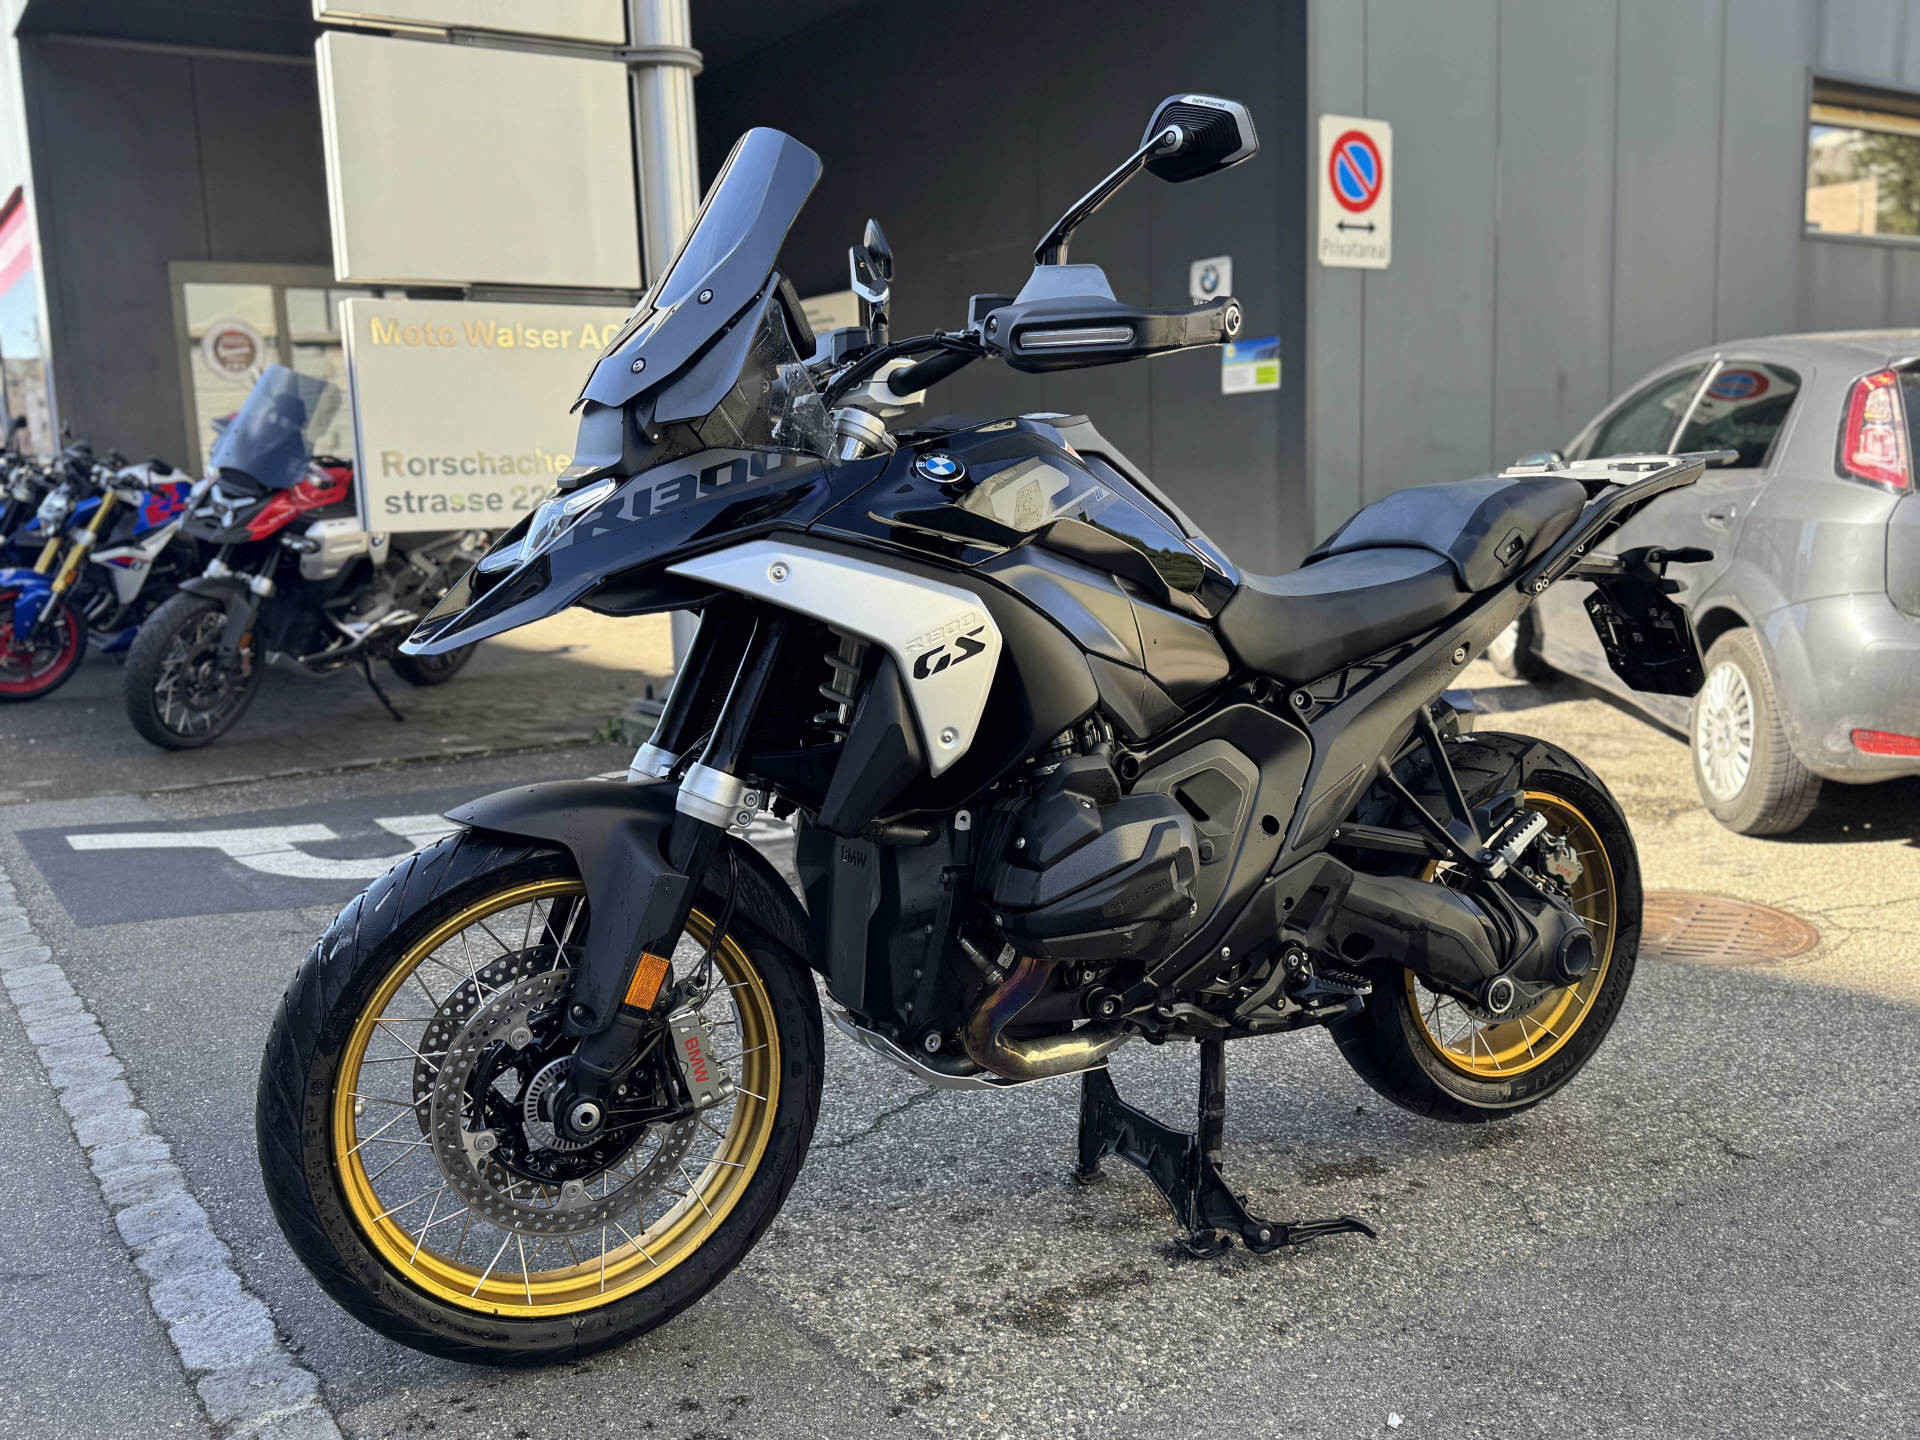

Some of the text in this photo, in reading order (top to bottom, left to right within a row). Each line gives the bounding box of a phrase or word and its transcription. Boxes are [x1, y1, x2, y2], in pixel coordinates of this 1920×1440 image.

[369, 316, 457, 347] Moto
[463, 319, 573, 349] Walser
[385, 490, 503, 515] strasse
[904, 612, 976, 655] R1300
[912, 625, 986, 680] GS
[685, 1036, 710, 1082] BMW
